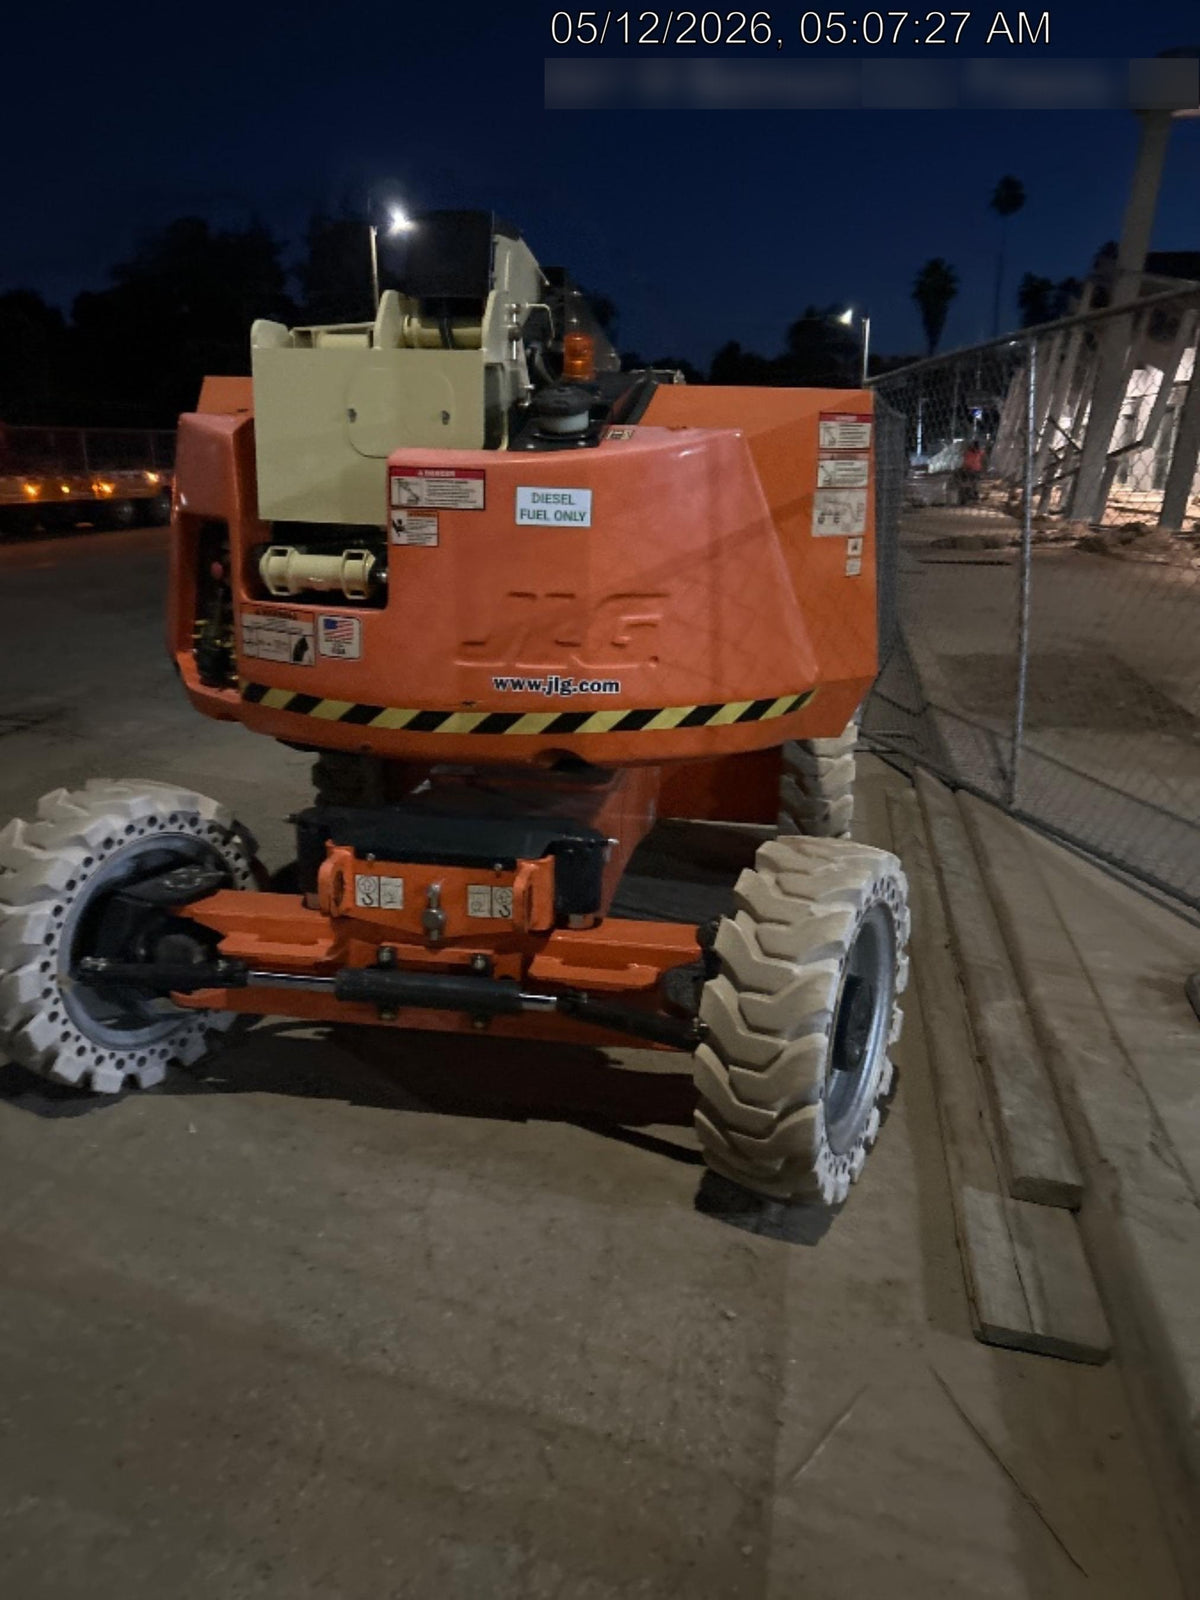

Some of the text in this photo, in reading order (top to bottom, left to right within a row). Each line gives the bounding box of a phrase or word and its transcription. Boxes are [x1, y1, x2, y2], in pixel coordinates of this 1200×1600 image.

[531, 491, 576, 506] DIESEL
[520, 508, 587, 522] FUEL ONLY
[492, 675, 621, 696] www.jlg.com
